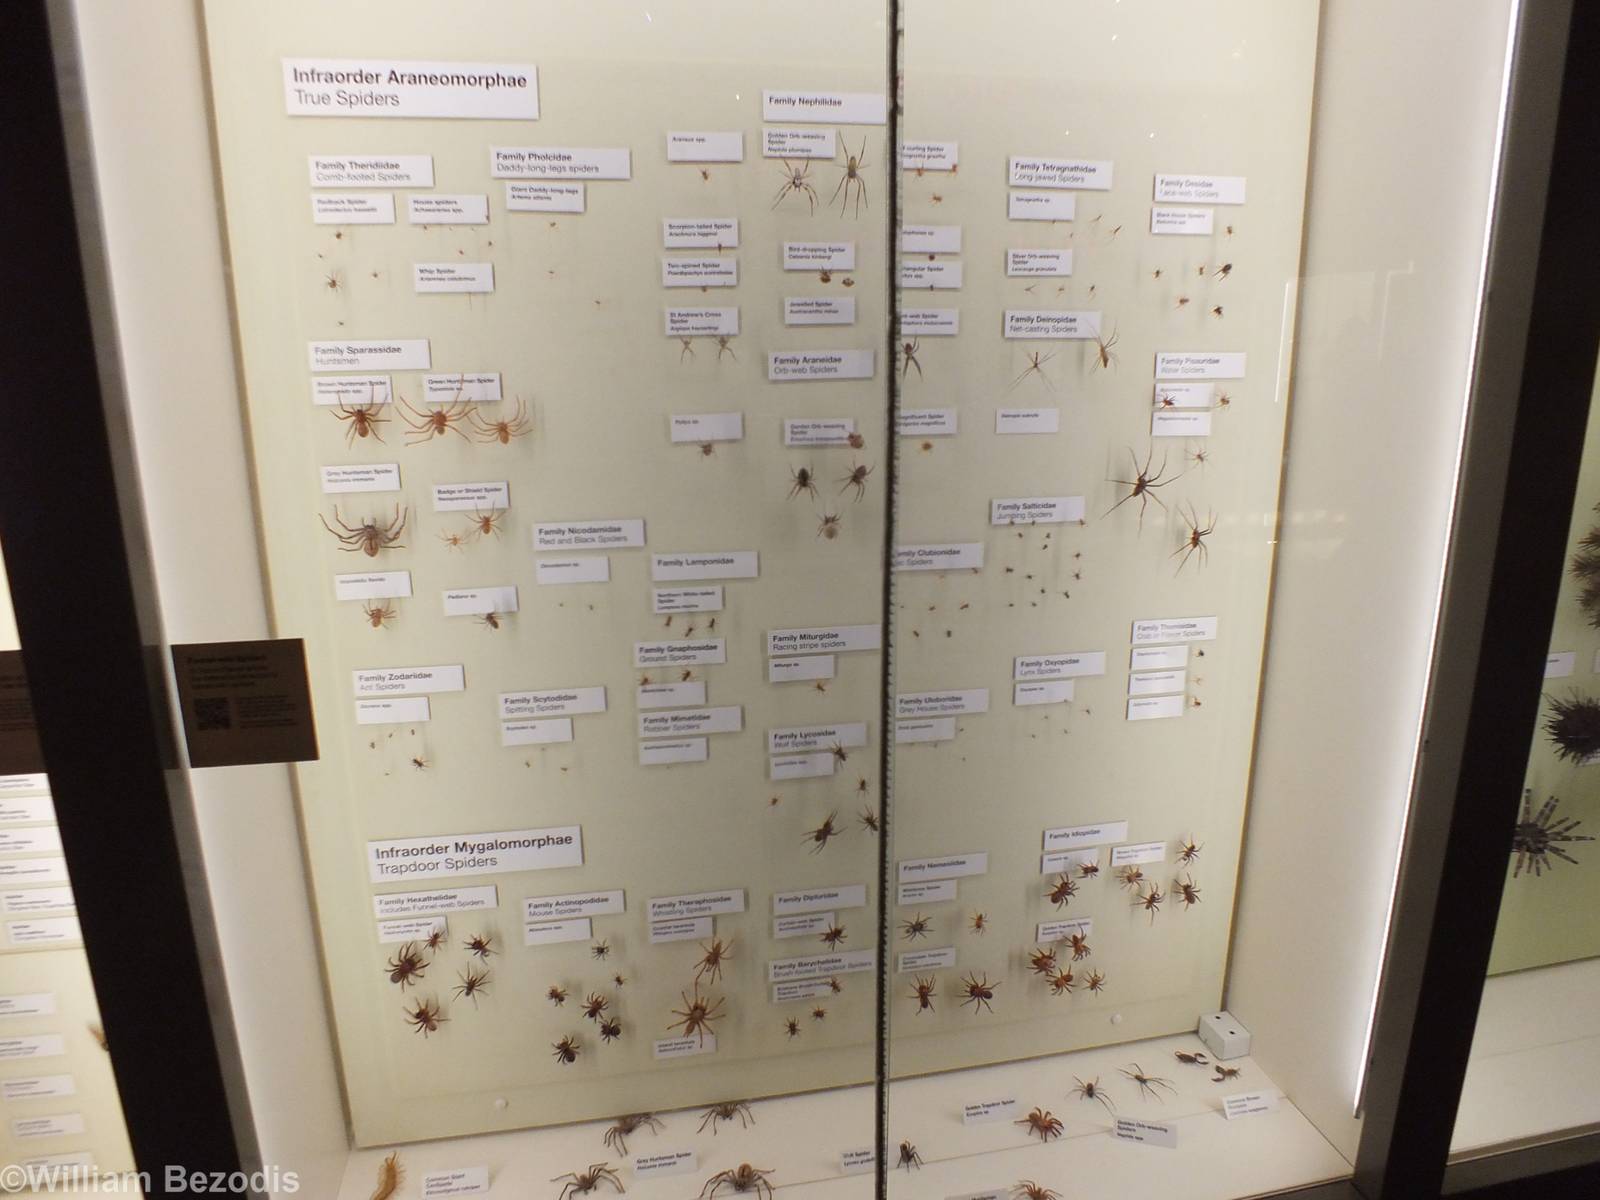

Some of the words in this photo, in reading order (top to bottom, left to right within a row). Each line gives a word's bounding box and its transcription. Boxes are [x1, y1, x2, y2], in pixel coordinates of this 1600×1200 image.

[294, 68, 382, 85] Infraorder
[388, 70, 527, 91] Araneomorphae
[296, 91, 330, 106] True
[336, 92, 400, 108] Spiders
[770, 97, 796, 108] Family
[799, 98, 842, 109] Nephilidae
[497, 152, 525, 162] Family
[528, 152, 572, 162] Pholcidae
[316, 161, 346, 172] Family
[350, 162, 400, 171] Theridiidae
[497, 164, 566, 174] Daddy-long-legs
[569, 164, 599, 175] spiders
[1015, 162, 1039, 172] Family
[1042, 163, 1096, 174] Tetragnathidae
[316, 172, 376, 182] Comb-footed
[378, 172, 411, 182] Spiders
[1058, 174, 1084, 184] Spiders
[1160, 179, 1182, 188] Family
[1010, 316, 1034, 324] Family
[1036, 316, 1077, 324] Deinopidae
[1010, 326, 1050, 334] Net-casting
[1051, 326, 1078, 335] Spiders
[315, 346, 345, 356] Family
[347, 345, 402, 356] Sparassidae
[774, 356, 801, 366] Family
[803, 356, 842, 364] Araneidae
[1161, 357, 1183, 366] Family
[774, 366, 808, 375] Orb-web
[810, 365, 838, 376] Spiders
[998, 504, 1020, 512] Family
[1022, 502, 1056, 510] Salticidae
[996, 512, 1026, 520] Jumping
[1027, 511, 1052, 520] Spiders
[539, 526, 565, 537] Family
[568, 525, 622, 536] Nicodamidae
[539, 537, 555, 545] Red
[557, 536, 572, 544] and
[575, 536, 596, 544] Black
[598, 534, 628, 544] Spiders
[917, 548, 960, 557] Clubionidae
[658, 558, 683, 568] Family
[686, 558, 734, 567] Lamponidae
[906, 558, 933, 567] Spiders
[1138, 624, 1158, 632] Family
[773, 635, 796, 644] Family
[800, 632, 839, 642] Miturgidae
[640, 646, 664, 655] Family
[667, 644, 718, 654] Gnaphosidae
[773, 642, 797, 652] Racing
[799, 642, 819, 650] stripe
[820, 640, 846, 650] spiders
[640, 654, 666, 662] Ground
[669, 653, 696, 662] Spiders
[1020, 660, 1042, 670] Family
[1044, 658, 1079, 667] Oxyopidae
[1037, 668, 1060, 676] Spiders
[359, 674, 387, 684] Family
[388, 672, 433, 682] Zodariidae
[376, 681, 406, 692] Spiders
[505, 697, 530, 706] Family
[533, 694, 577, 704] Scytodidae
[900, 697, 922, 706] Family
[505, 705, 534, 715] Spitting
[536, 703, 565, 713] Spiders
[940, 704, 965, 712] Spiders
[644, 716, 669, 726] Family
[671, 714, 710, 722] Mimetidae
[672, 724, 700, 732] Spiders
[774, 732, 797, 742] Family
[800, 730, 836, 740] Lycosidae
[791, 739, 817, 748] Spiders
[1049, 832, 1069, 841] Family
[376, 844, 450, 860] Infraorder
[454, 834, 573, 858] Mygalomorphae
[378, 858, 440, 875] Trapdoor
[445, 856, 497, 872] Spiders
[904, 864, 925, 873] Family
[380, 898, 404, 907] Family
[407, 893, 458, 903] Hexathelidae
[528, 902, 553, 911] Family
[555, 896, 609, 908] Actinopodidae
[652, 902, 676, 912] Family
[678, 896, 731, 908] Theraphosidae
[779, 896, 802, 905] Family
[803, 892, 839, 902] Dipluridae
[413, 902, 456, 912] Funnel-web
[458, 898, 485, 908] Spiders
[686, 905, 712, 915] Spiders
[529, 909, 554, 917] Mouse
[556, 906, 582, 916] Spiders
[774, 963, 796, 972] Family
[798, 958, 842, 969] Barychelidae
[848, 961, 872, 970] Spiders
